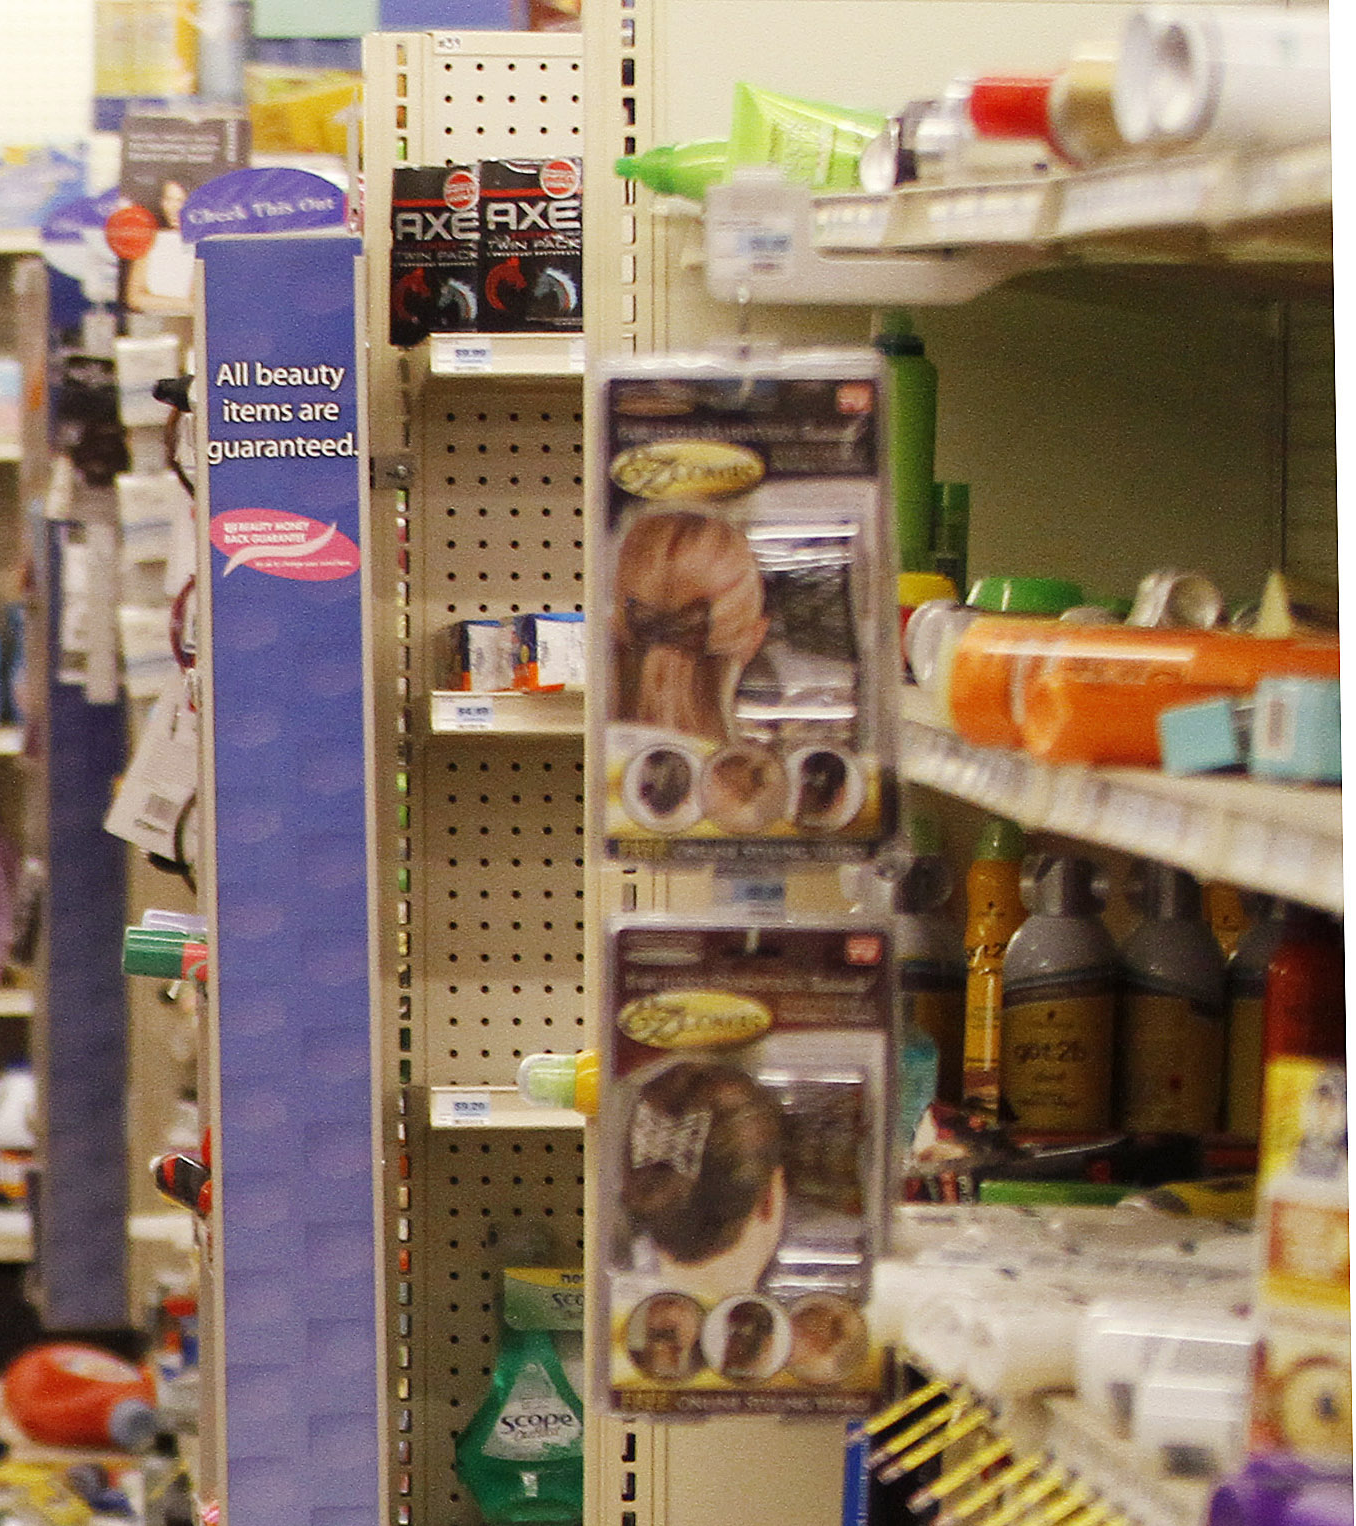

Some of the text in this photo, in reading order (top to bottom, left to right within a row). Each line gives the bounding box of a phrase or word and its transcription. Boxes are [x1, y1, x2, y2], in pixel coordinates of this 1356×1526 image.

[187, 197, 336, 224] Check This Out
[486, 200, 582, 231] AXE
[395, 211, 480, 241] AXE
[216, 361, 345, 391] All beauty
[222, 399, 339, 423] items are
[207, 432, 359, 465] guaranteed.
